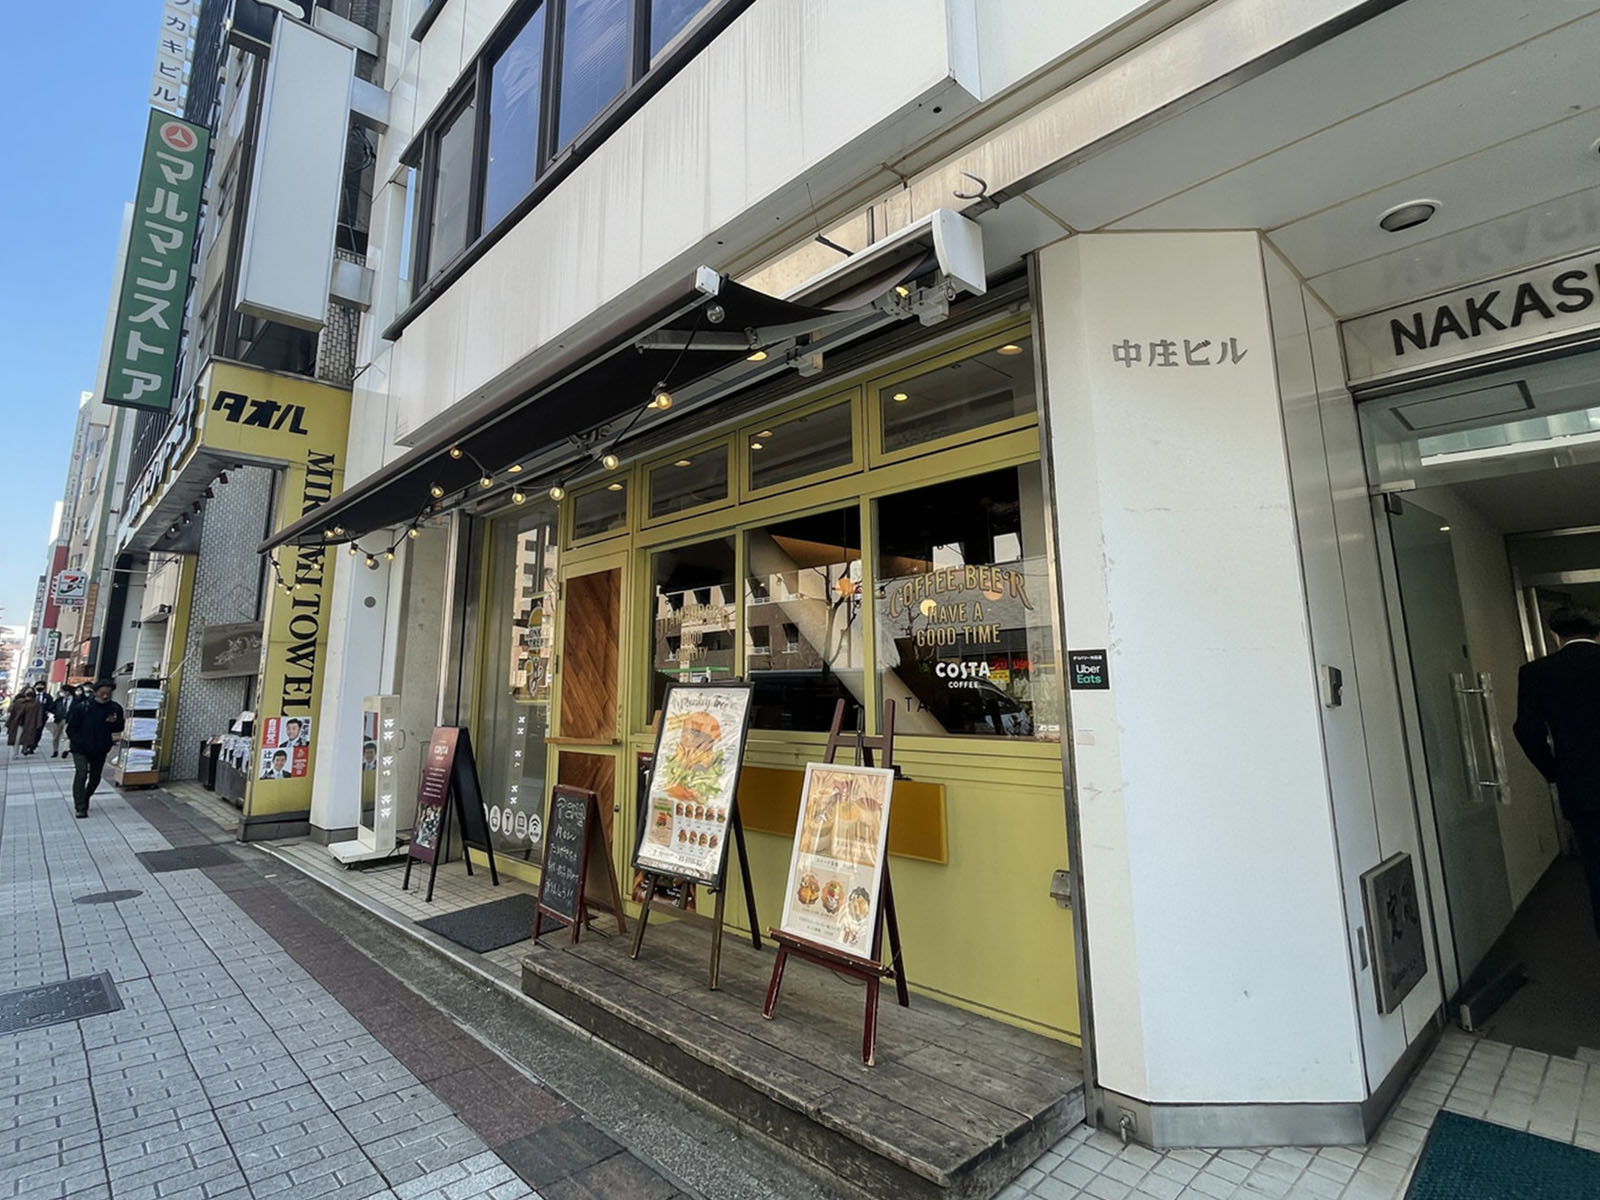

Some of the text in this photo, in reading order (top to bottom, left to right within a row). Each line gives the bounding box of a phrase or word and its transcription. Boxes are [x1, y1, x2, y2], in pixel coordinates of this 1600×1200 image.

[122, 151, 194, 400] マルマンストア
[1391, 265, 1600, 356] NAKAS
[1112, 337, 1248, 368] 中庄ビル
[211, 390, 309, 435] タオル
[281, 449, 335, 716] MIKMI TOWEL
[928, 601, 984, 625] HAVE A
[917, 623, 1001, 648] GOOD TIME
[935, 661, 991, 679] COSTA
[1075, 664, 1101, 674] Uber
[1076, 674, 1102, 684] Eats
[947, 681, 979, 690] COFFEE
